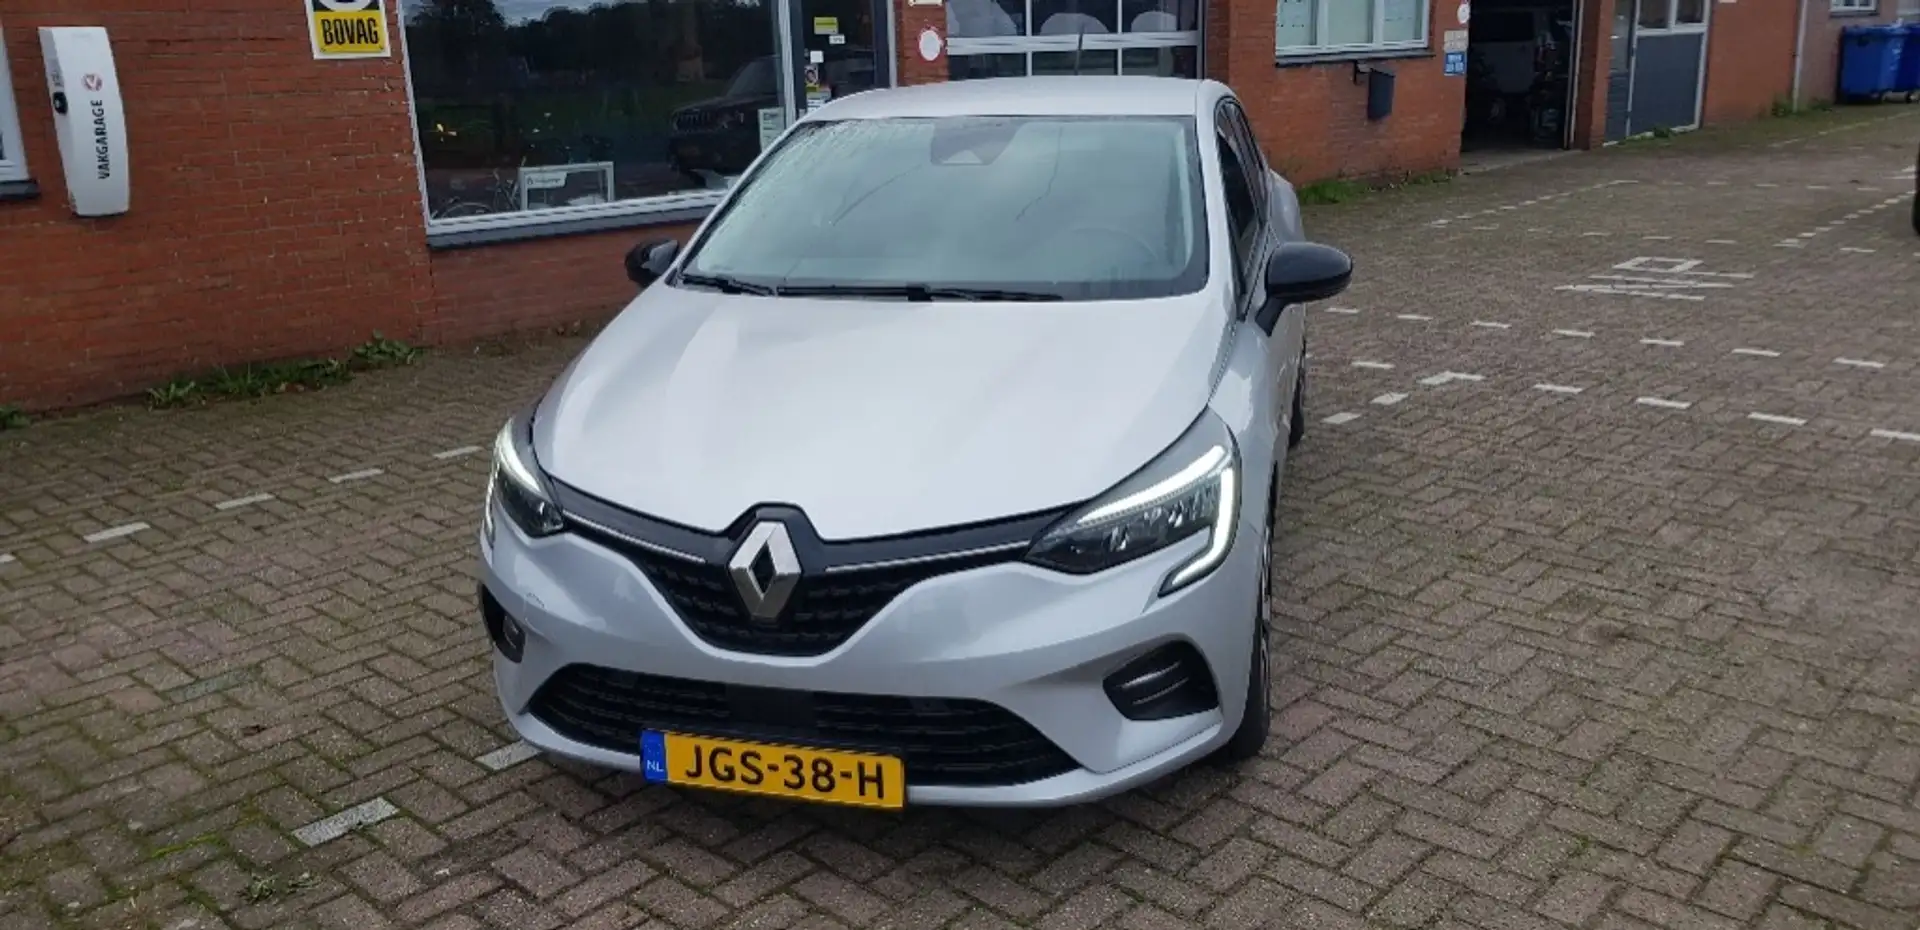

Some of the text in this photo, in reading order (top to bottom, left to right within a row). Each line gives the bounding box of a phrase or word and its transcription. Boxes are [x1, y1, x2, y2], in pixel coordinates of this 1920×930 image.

[320, 17, 379, 46] BOVAG
[91, 100, 110, 180] VAKGARAGE
[646, 744, 885, 800] NL JGS-38-H
